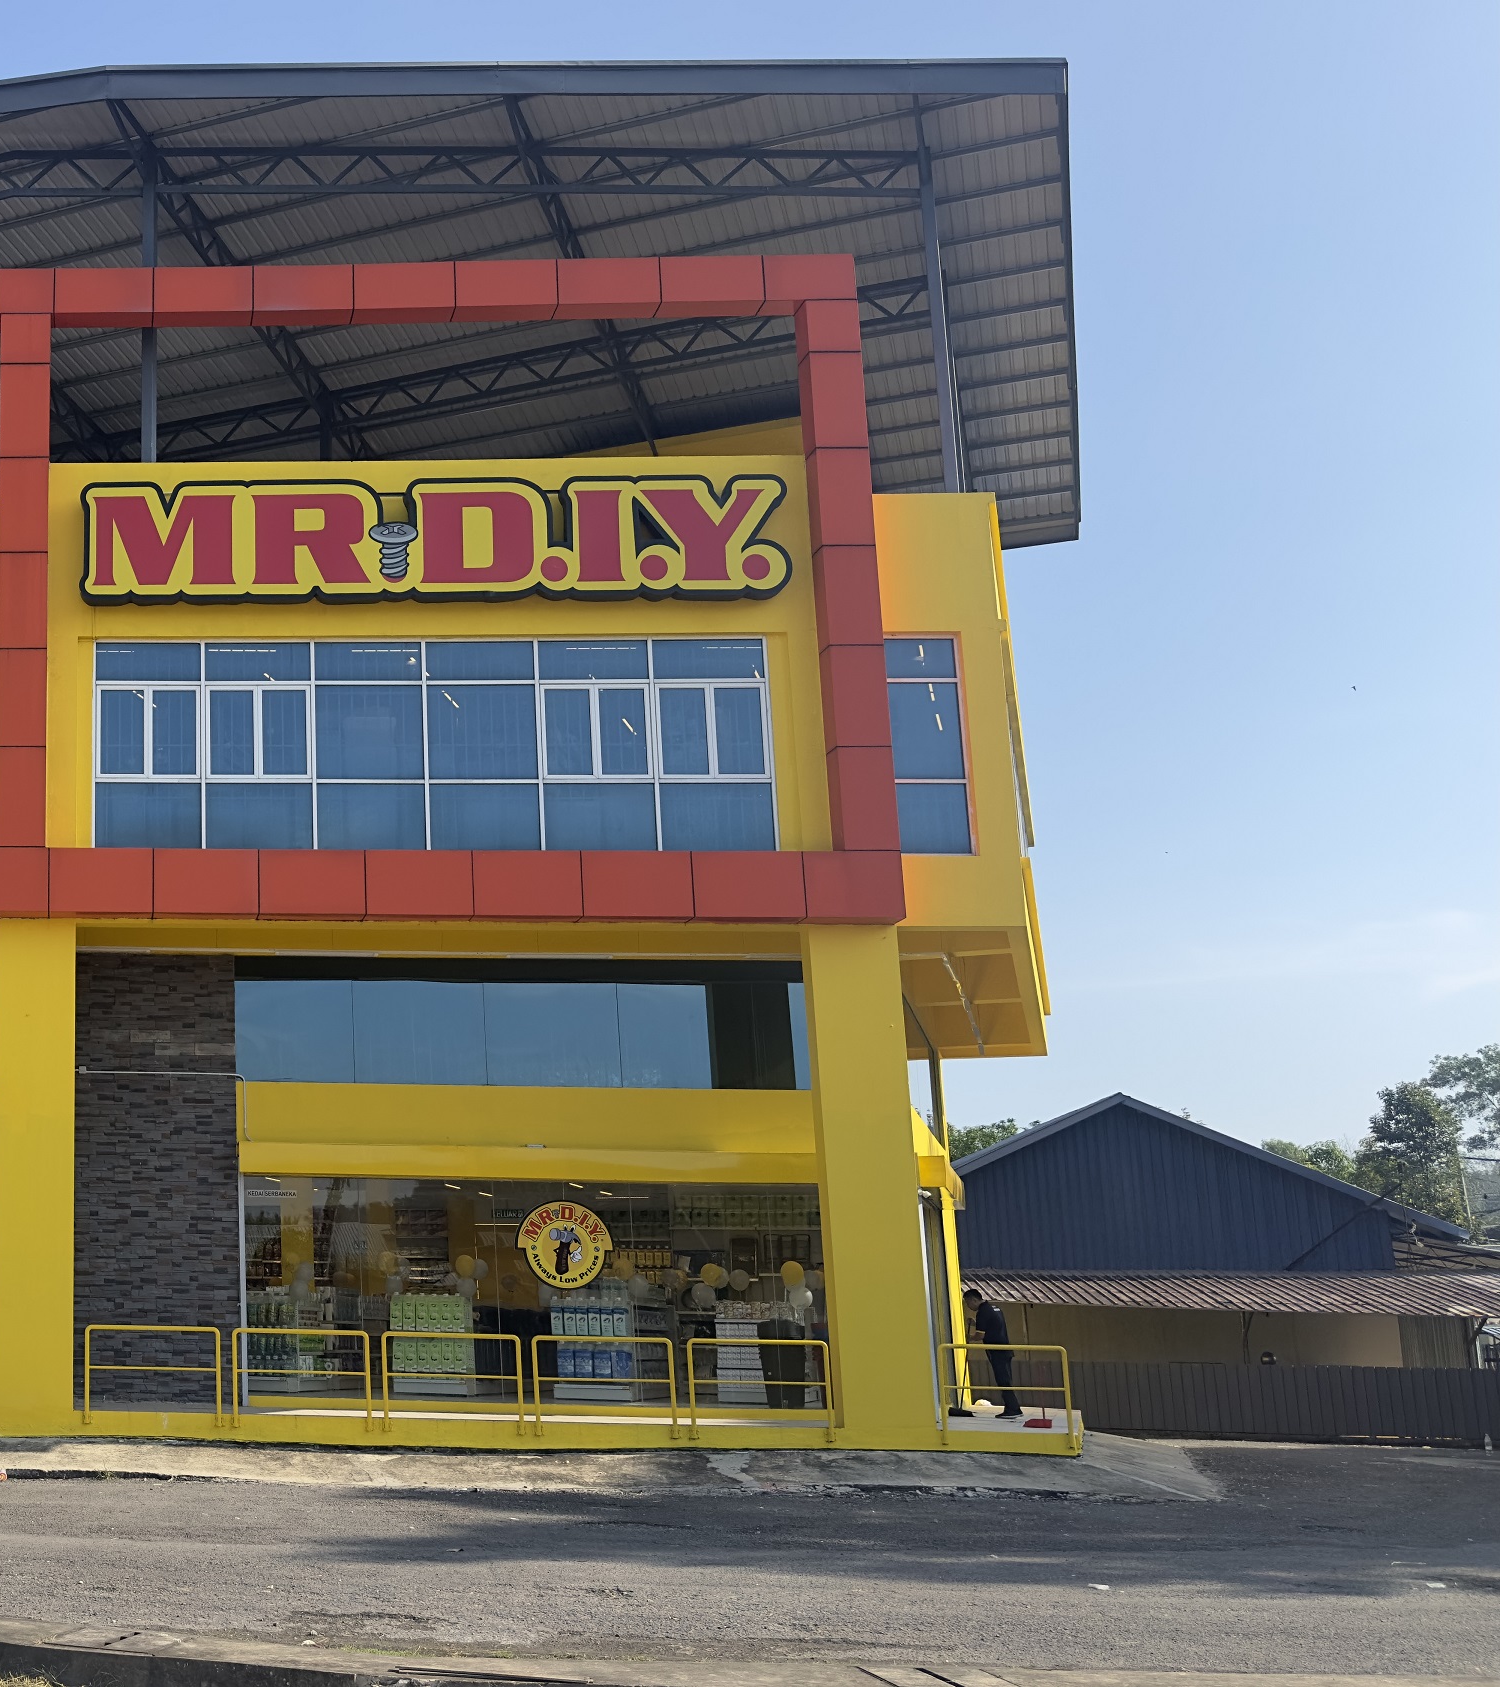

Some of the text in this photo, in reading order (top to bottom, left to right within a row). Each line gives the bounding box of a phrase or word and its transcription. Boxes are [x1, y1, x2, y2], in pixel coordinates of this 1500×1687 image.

[88, 486, 774, 588] MR D.I.Y.
[523, 1208, 556, 1241] MR
[532, 1252, 557, 1281] Always
[579, 1255, 599, 1280] Prices
